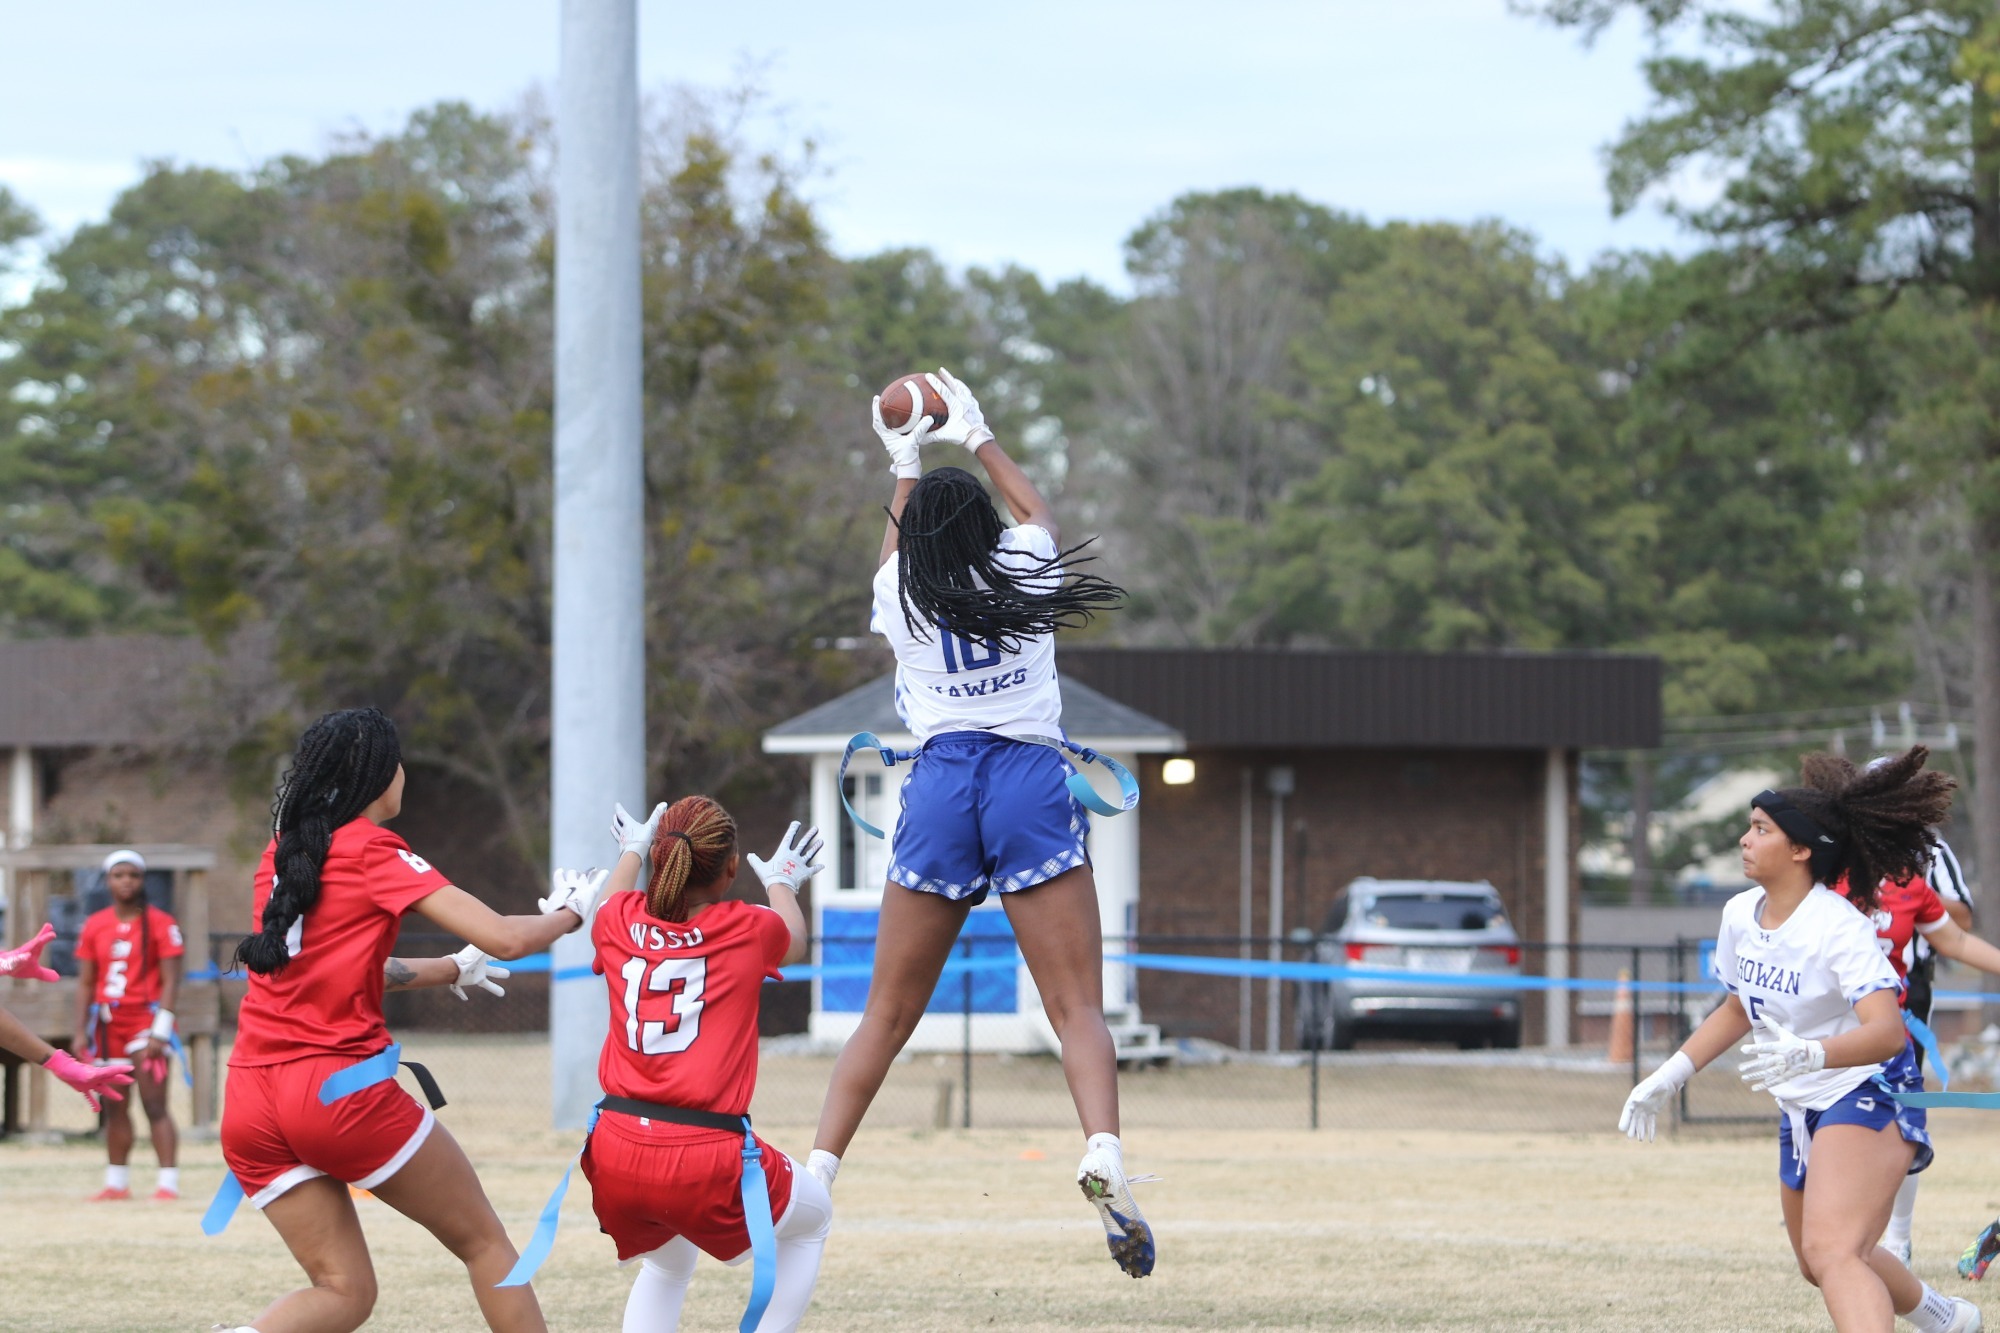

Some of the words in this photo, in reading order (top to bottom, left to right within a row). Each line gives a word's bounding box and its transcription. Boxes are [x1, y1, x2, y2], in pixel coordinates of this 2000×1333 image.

[397, 848, 432, 874] 8
[630, 922, 703, 951] WSSU
[103, 960, 129, 998] 5
[1737, 955, 1801, 996] HOWAN
[621, 955, 707, 1056] 13
